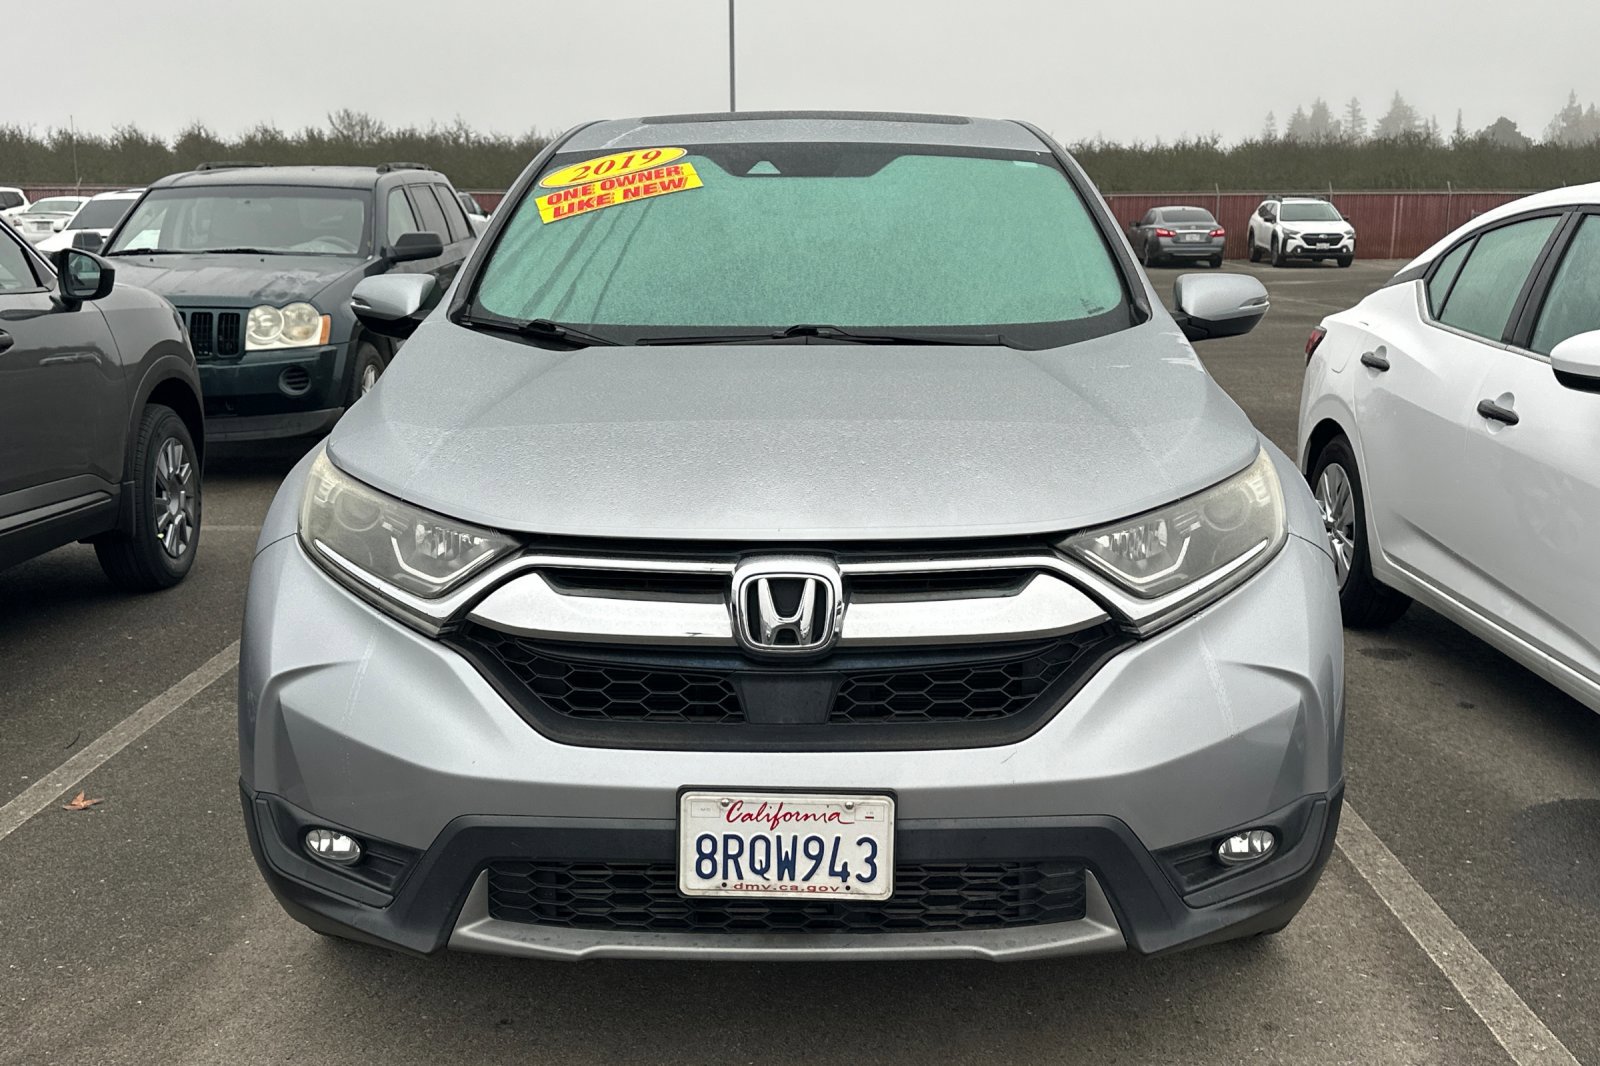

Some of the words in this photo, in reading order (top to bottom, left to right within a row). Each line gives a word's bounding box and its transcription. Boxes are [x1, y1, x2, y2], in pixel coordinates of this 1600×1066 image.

[569, 150, 662, 182] 2019
[547, 184, 596, 206] ONE
[600, 165, 684, 191] OWNER
[553, 192, 615, 219] LIKE
[622, 177, 689, 201] NEW
[726, 800, 855, 831] California
[695, 833, 878, 883] 8RQW943
[733, 882, 840, 892] dmv.ca.gov
